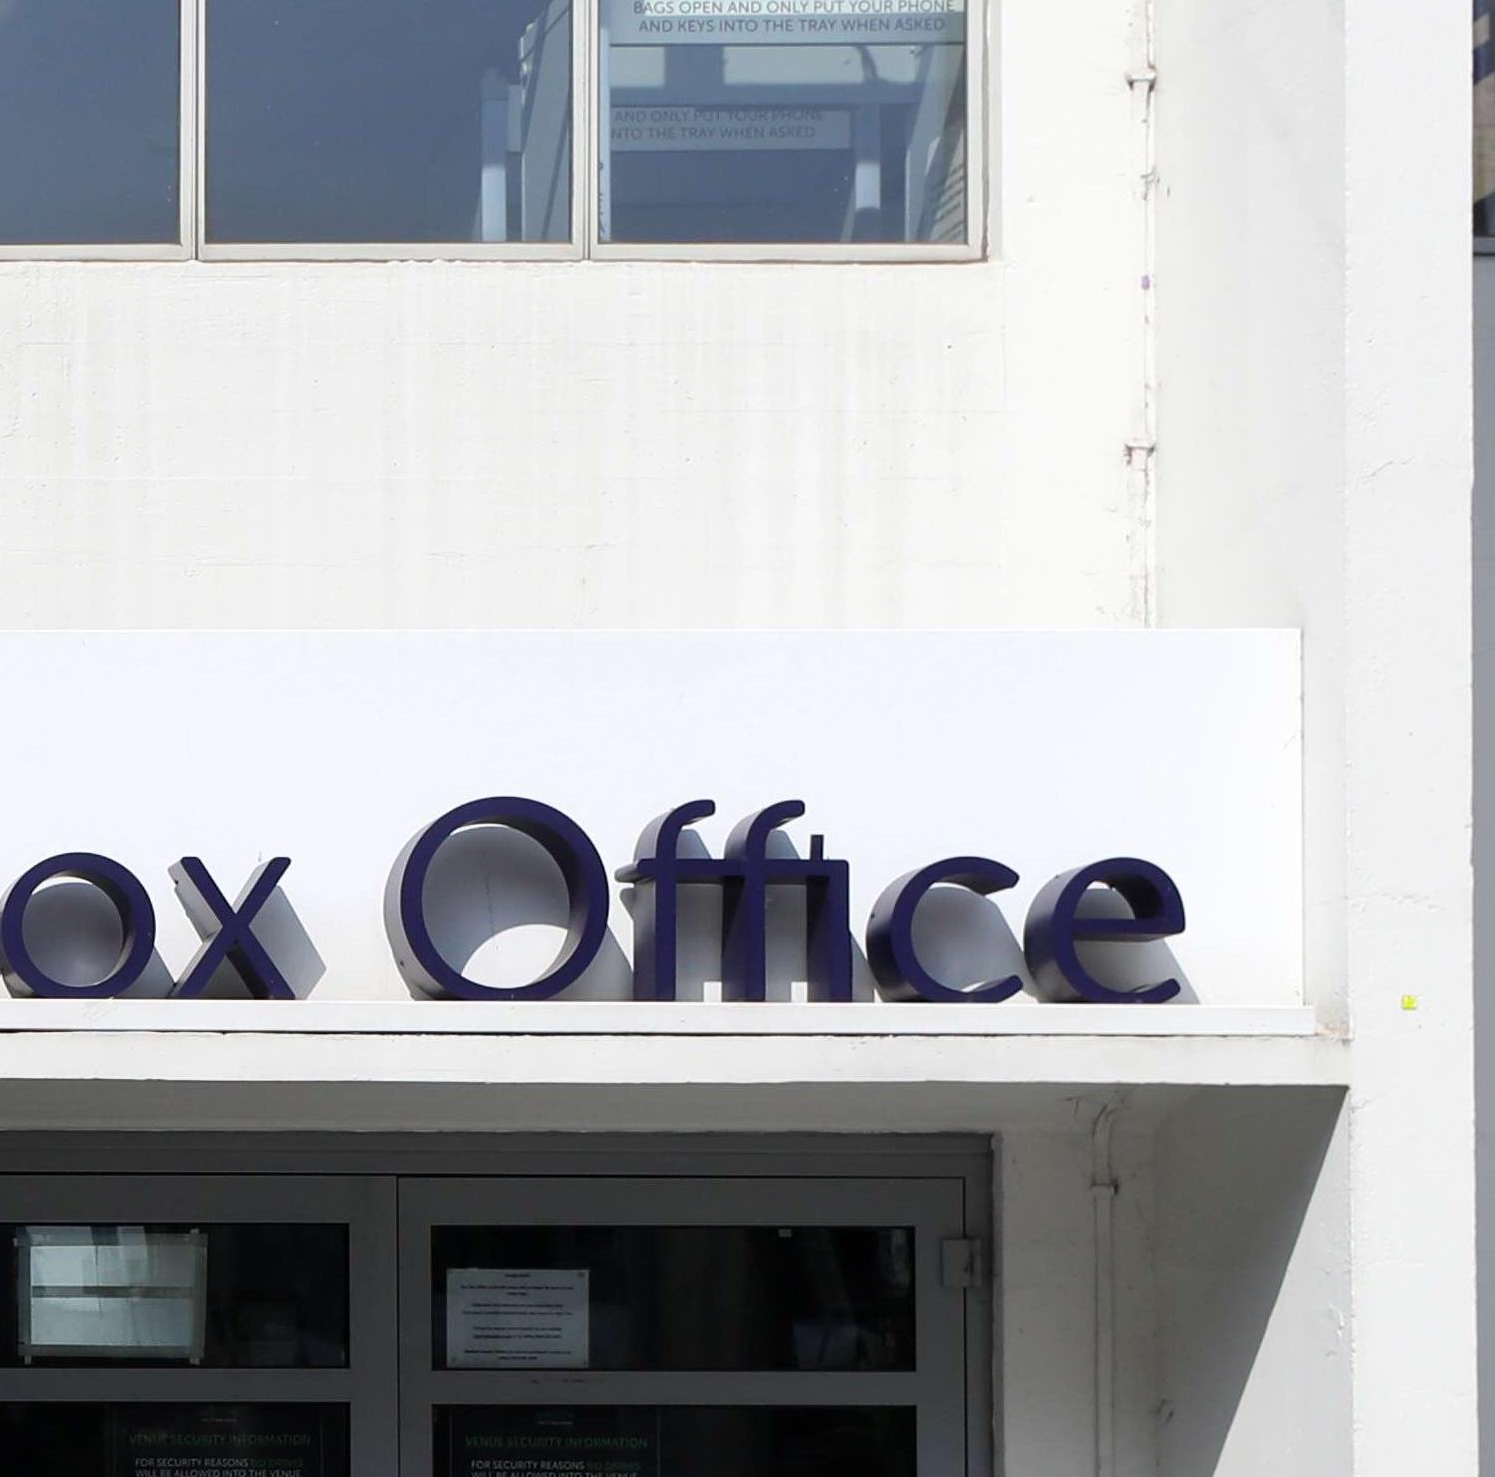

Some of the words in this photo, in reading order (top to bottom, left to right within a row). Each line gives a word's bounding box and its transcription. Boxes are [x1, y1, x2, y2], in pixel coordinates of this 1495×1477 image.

[633, 1, 674, 14] BAGS
[679, 1, 722, 13] OPEN
[727, 1, 762, 13] AND
[766, 0, 809, 13] ONLY
[814, 0, 844, 12] PUT
[848, 0, 894, 12] YOUR
[898, 0, 954, 12] PHONE
[638, 19, 673, 32] AND
[678, 19, 715, 32] KEYS
[719, 19, 758, 32] INTO
[763, 19, 794, 31] THE
[799, 19, 837, 31] TRAY
[840, 18, 890, 31] WHEN
[894, 18, 947, 31] ASKED
[611, 127, 644, 140] NTO
[391, 795, 1187, 1004] Office
[135, 1457, 156, 1467] FOR
[157, 1457, 203, 1467] SECURITY
[204, 1457, 249, 1467] REASONS
[471, 1460, 492, 1470] FOR
[493, 1460, 539, 1470] SECURITY
[540, 1460, 586, 1470] REASONS
